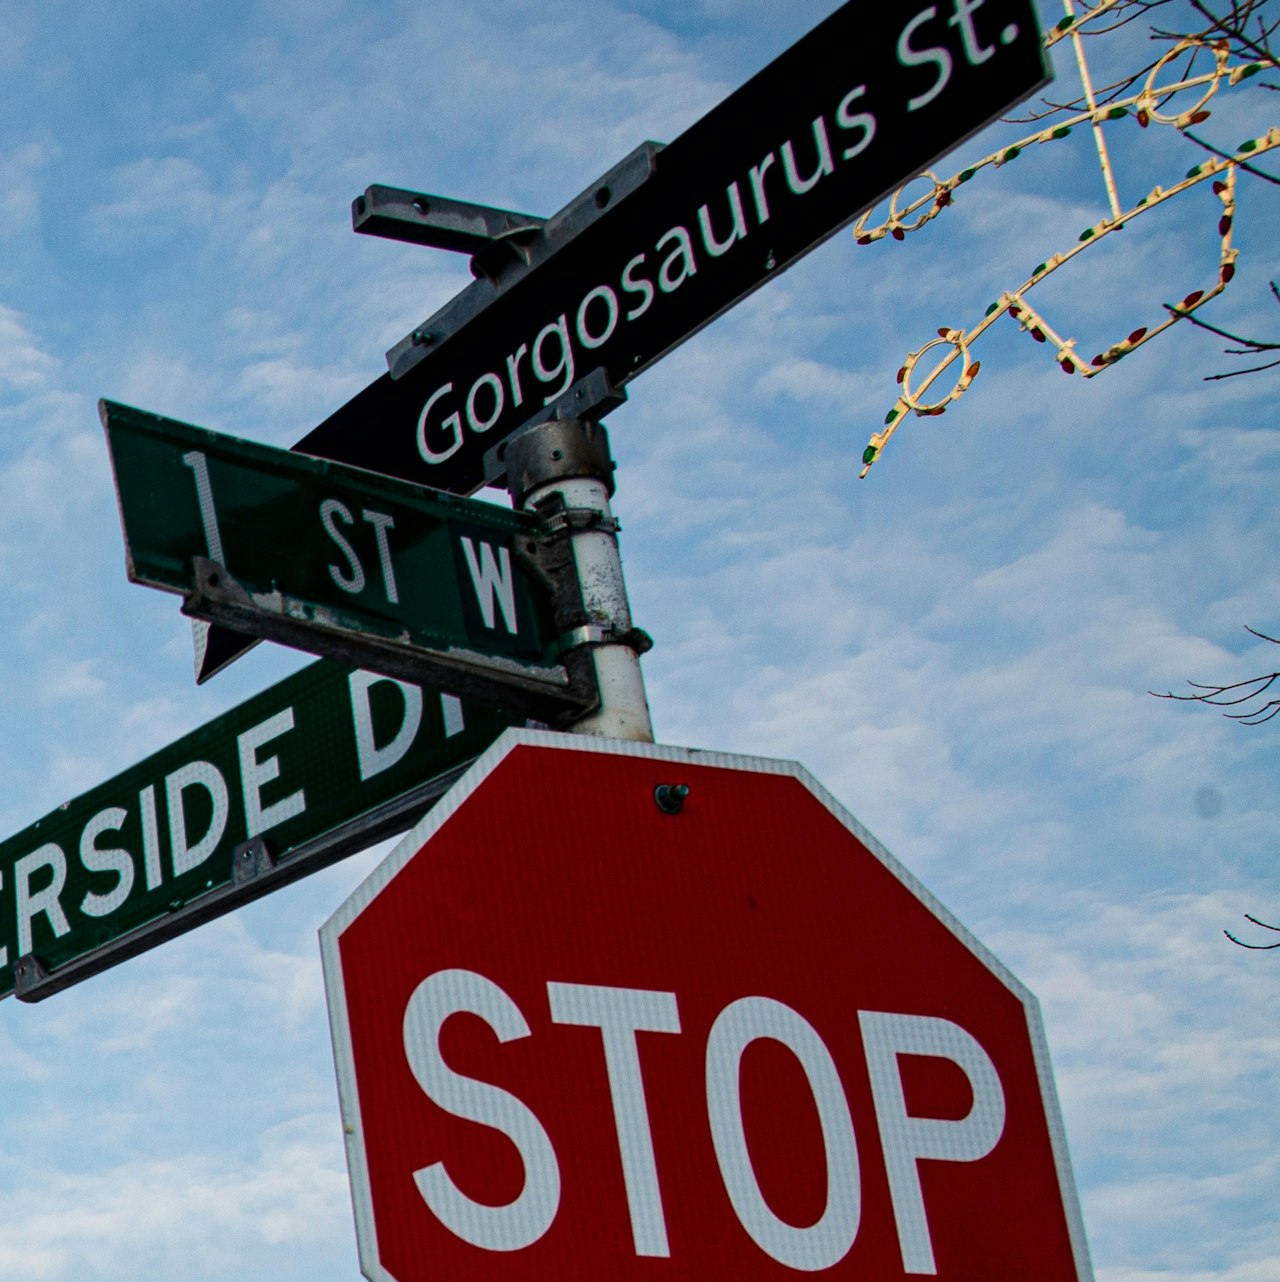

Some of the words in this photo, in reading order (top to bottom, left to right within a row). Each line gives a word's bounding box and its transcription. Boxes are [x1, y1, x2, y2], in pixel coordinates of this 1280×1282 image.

[416, 84, 877, 465] Gorgosaurus
[896, 0, 1020, 112] St.
[319, 499, 399, 604] ST
[459, 535, 518, 635] W
[401, 967, 1007, 1276] STOP
